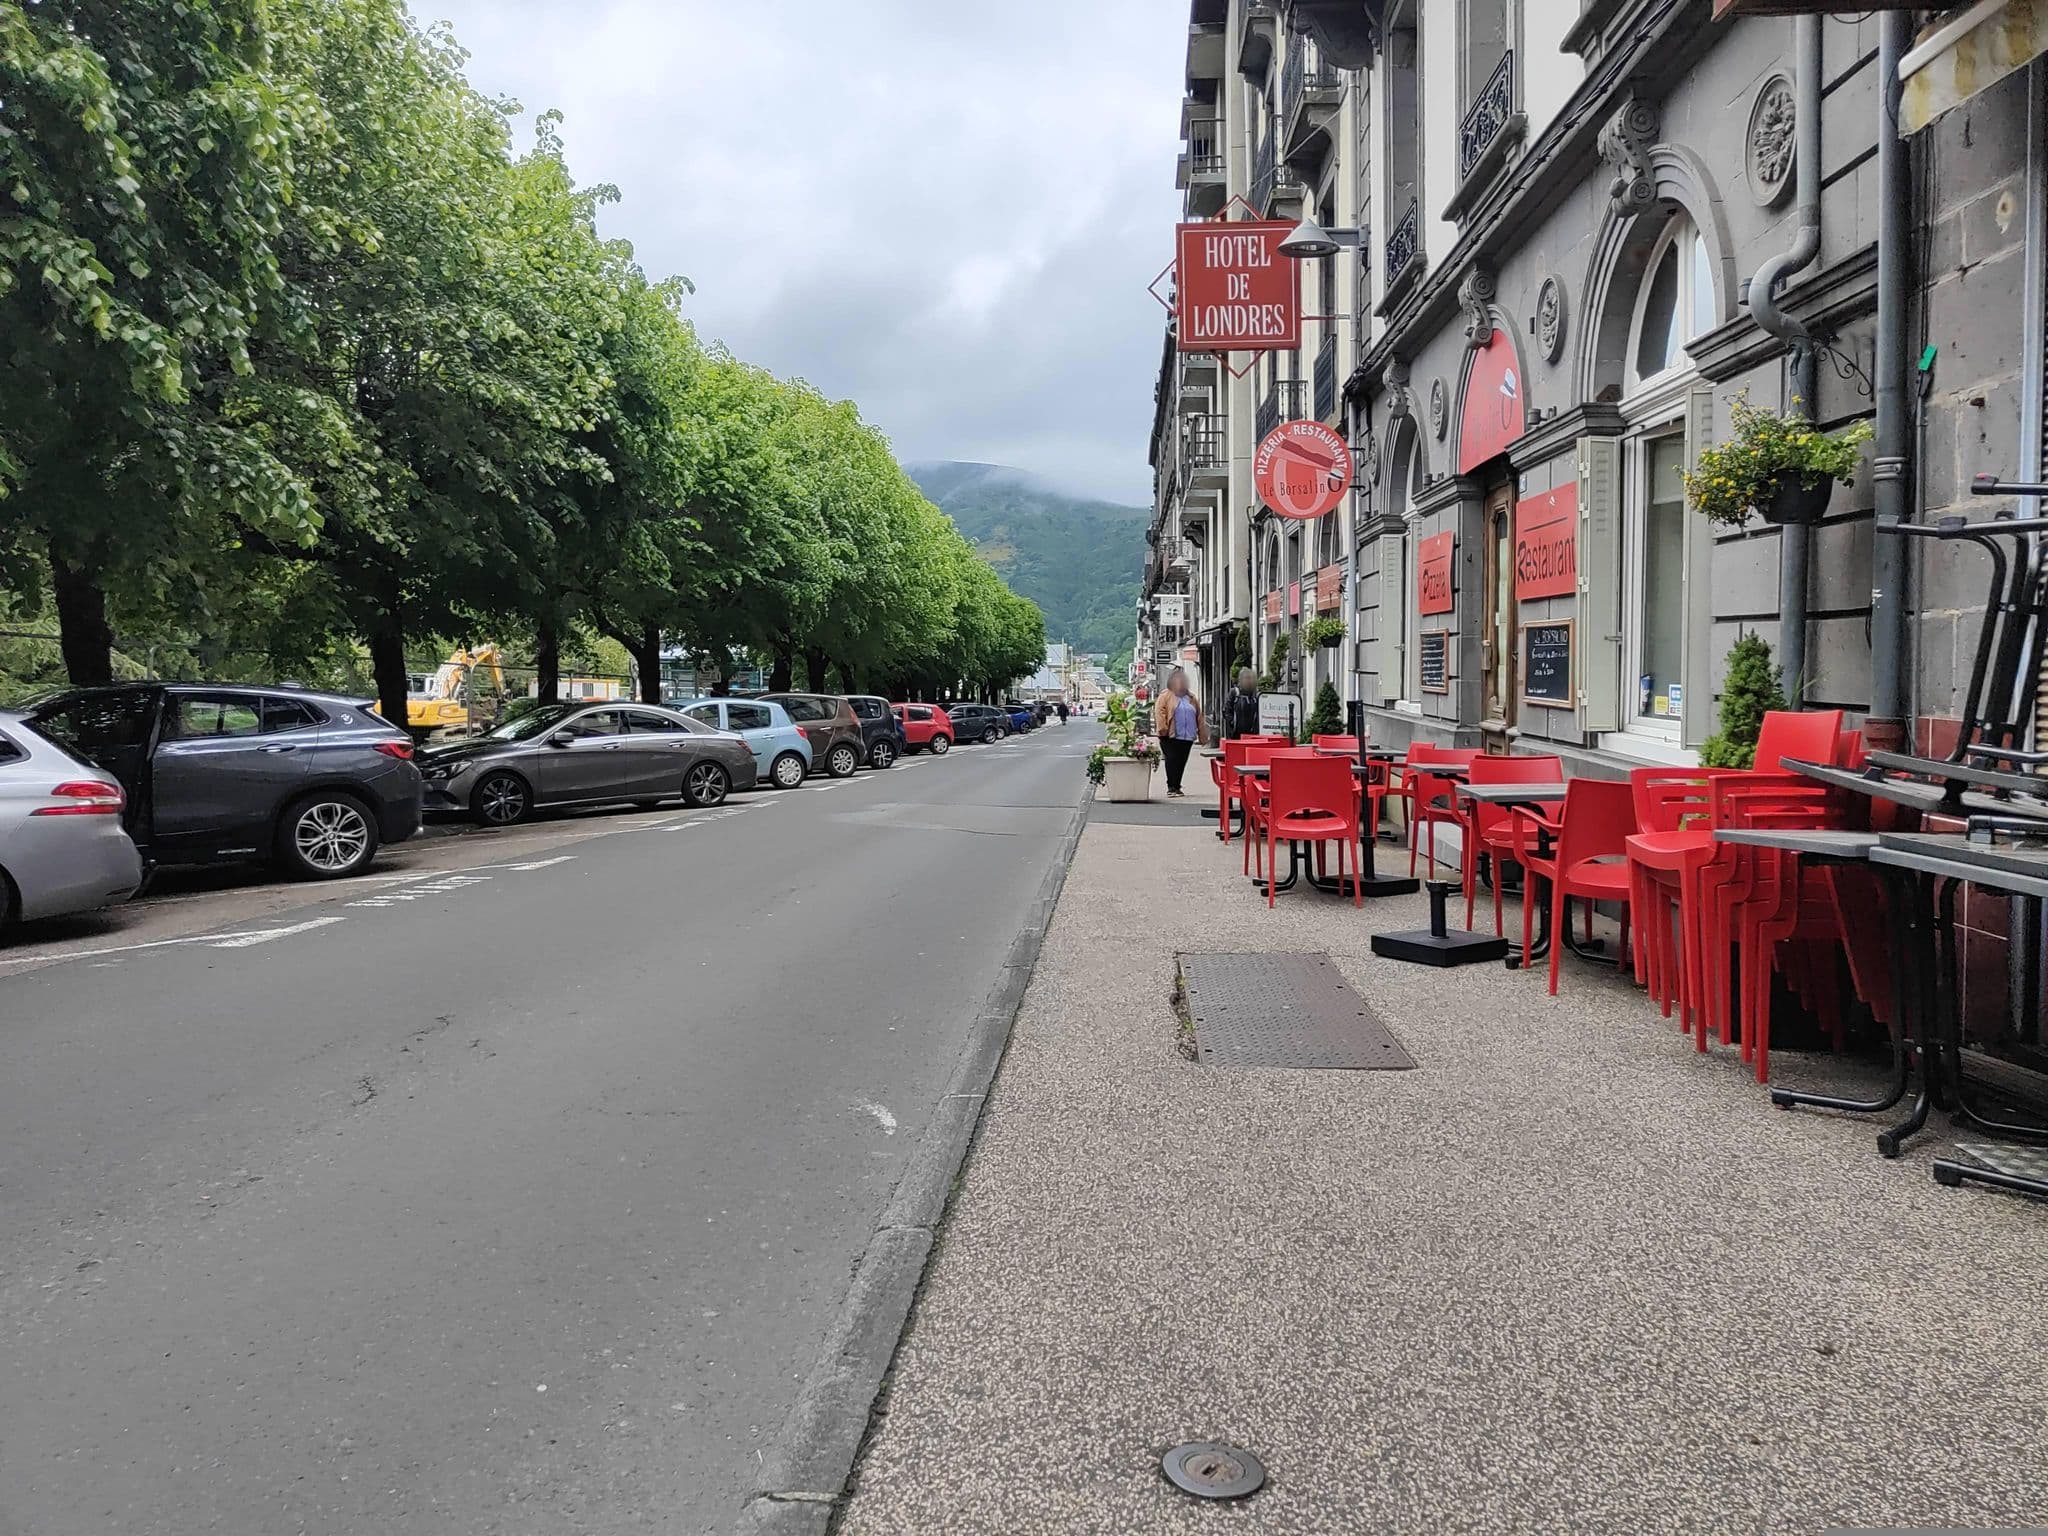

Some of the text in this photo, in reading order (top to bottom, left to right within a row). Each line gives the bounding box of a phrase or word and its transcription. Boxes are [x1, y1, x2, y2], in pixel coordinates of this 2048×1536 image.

[1205, 235, 1271, 268] HOTEL
[1227, 273, 1250, 300] DE
[1194, 304, 1285, 337] LONDRES
[1293, 424, 1347, 469] RESTAURANT
[1517, 528, 1577, 585] Restaurant
